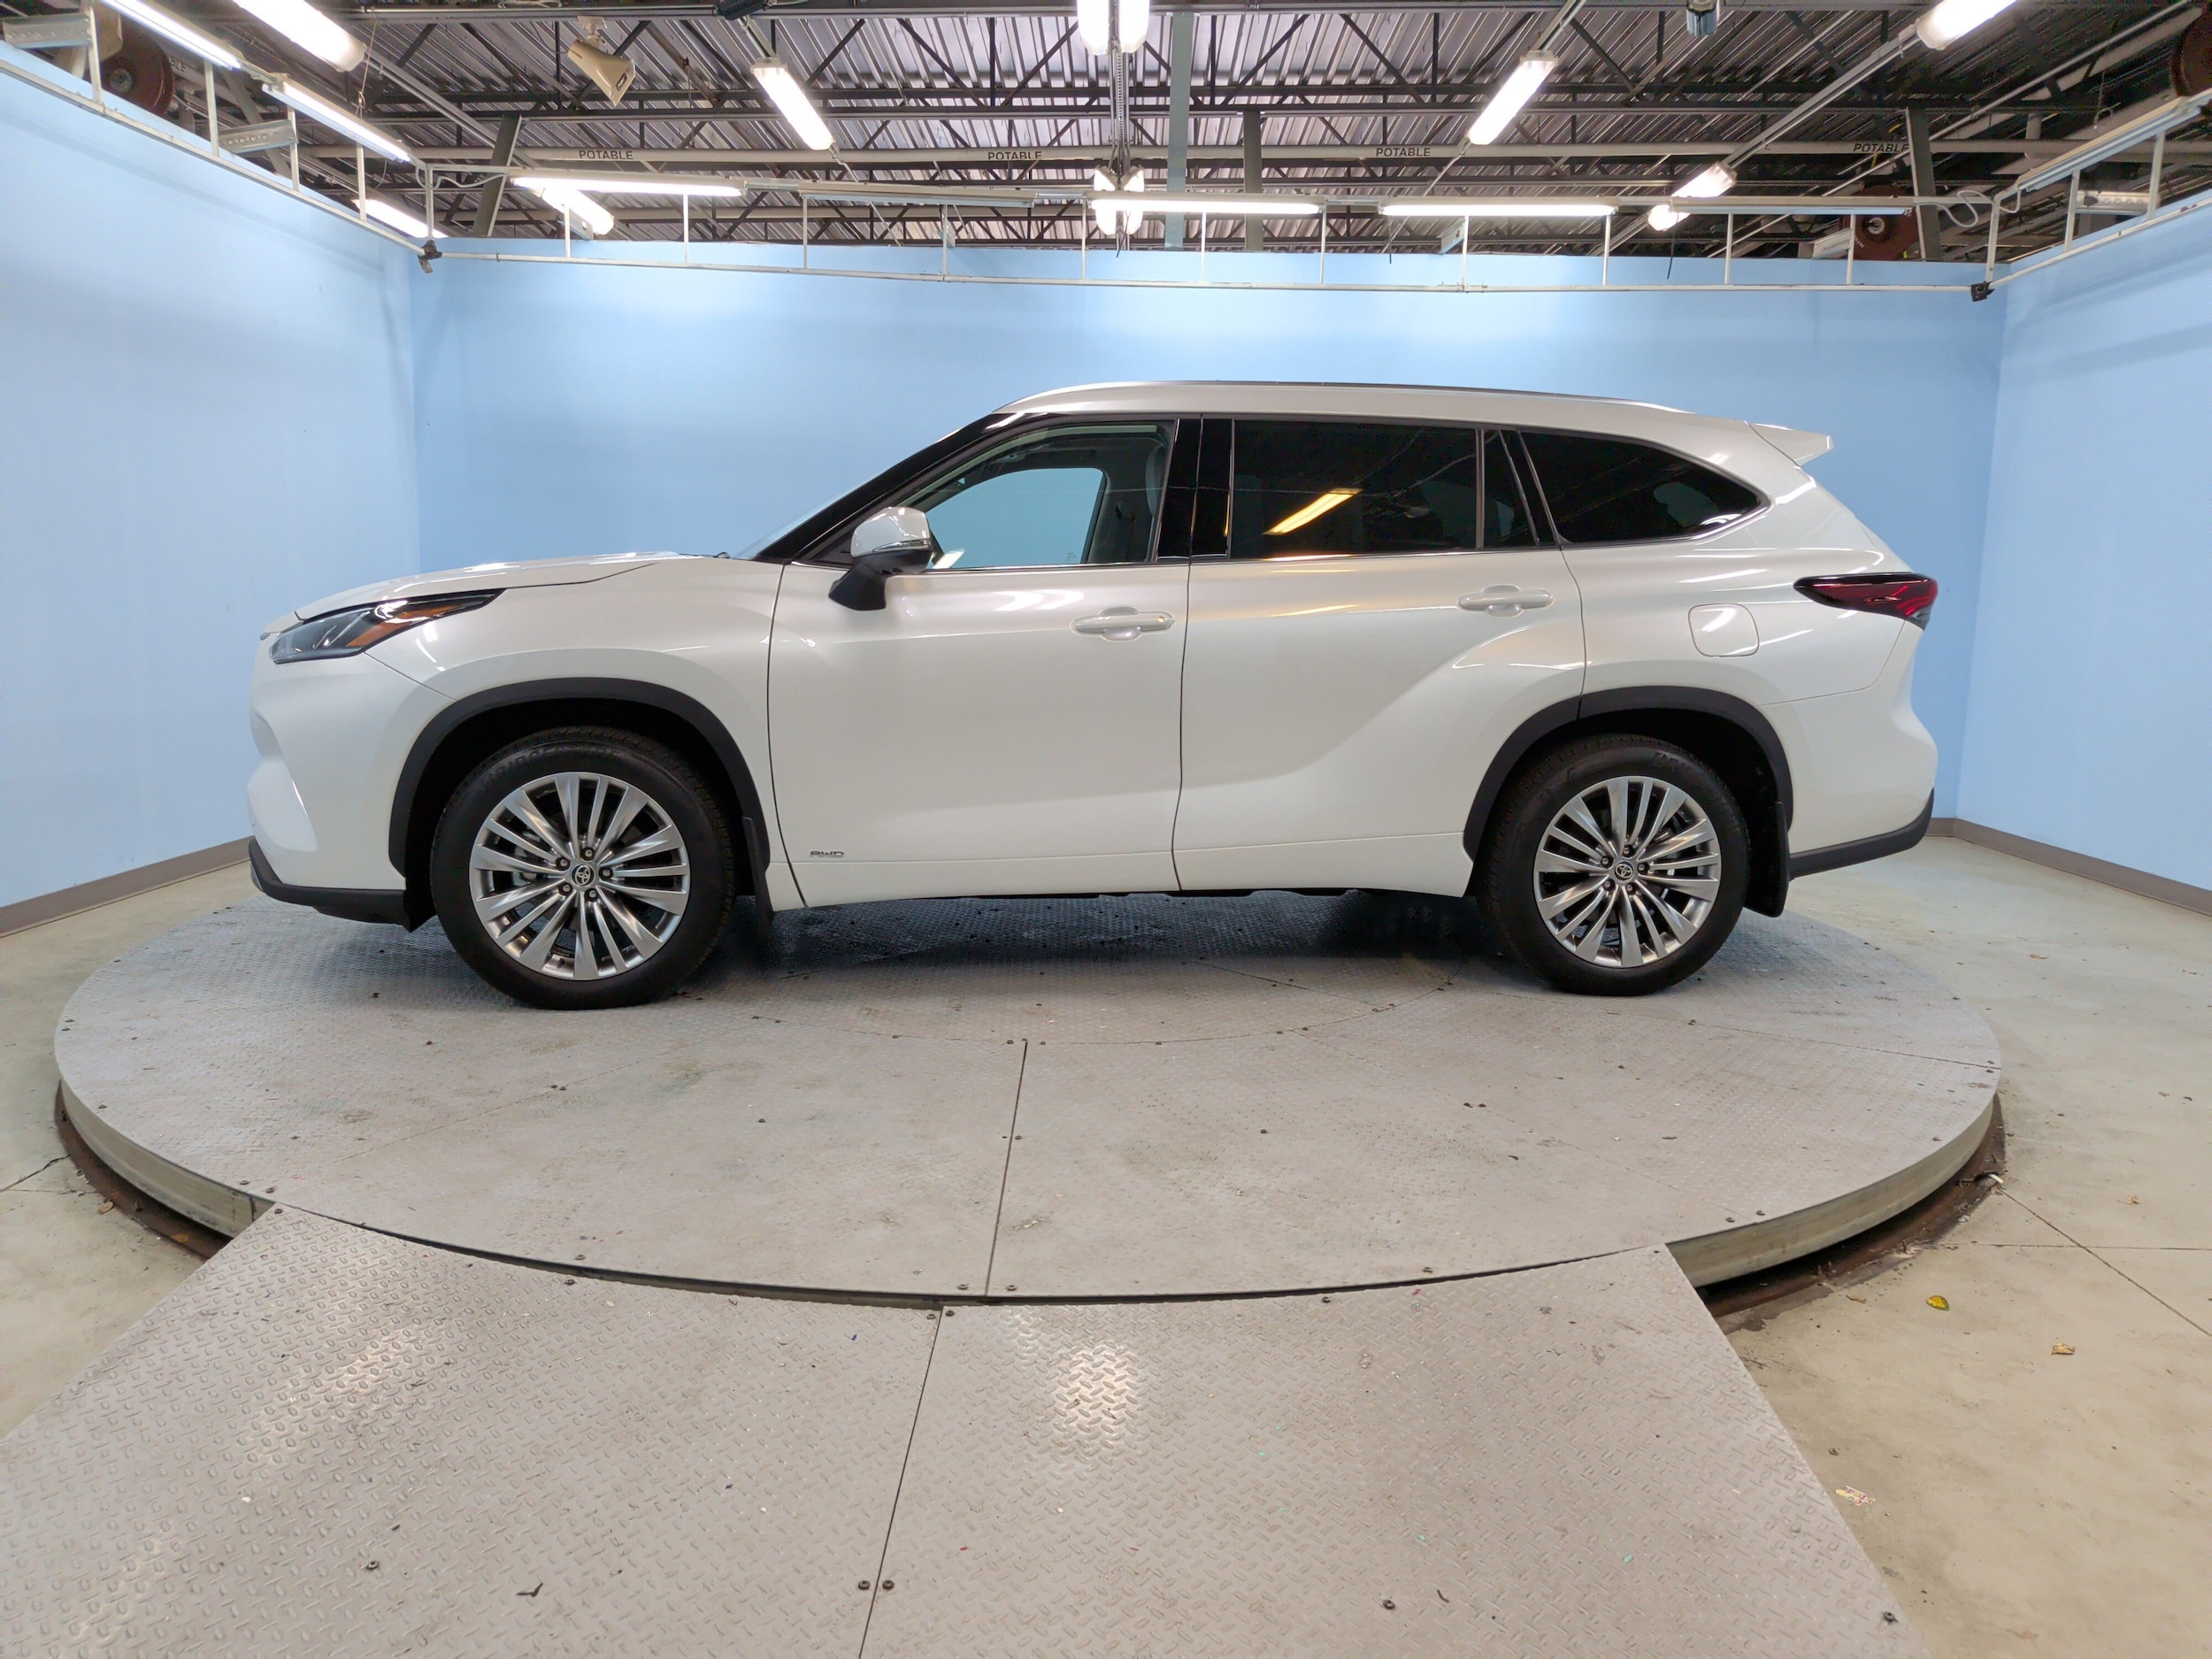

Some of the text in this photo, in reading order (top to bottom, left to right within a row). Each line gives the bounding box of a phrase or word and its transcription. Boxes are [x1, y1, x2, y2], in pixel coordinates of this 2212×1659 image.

[1376, 147, 1431, 157] POTABLE
[1853, 142, 1910, 153] POTABLE
[579, 150, 634, 160] POTABLE
[987, 150, 1042, 160] POTABLE
